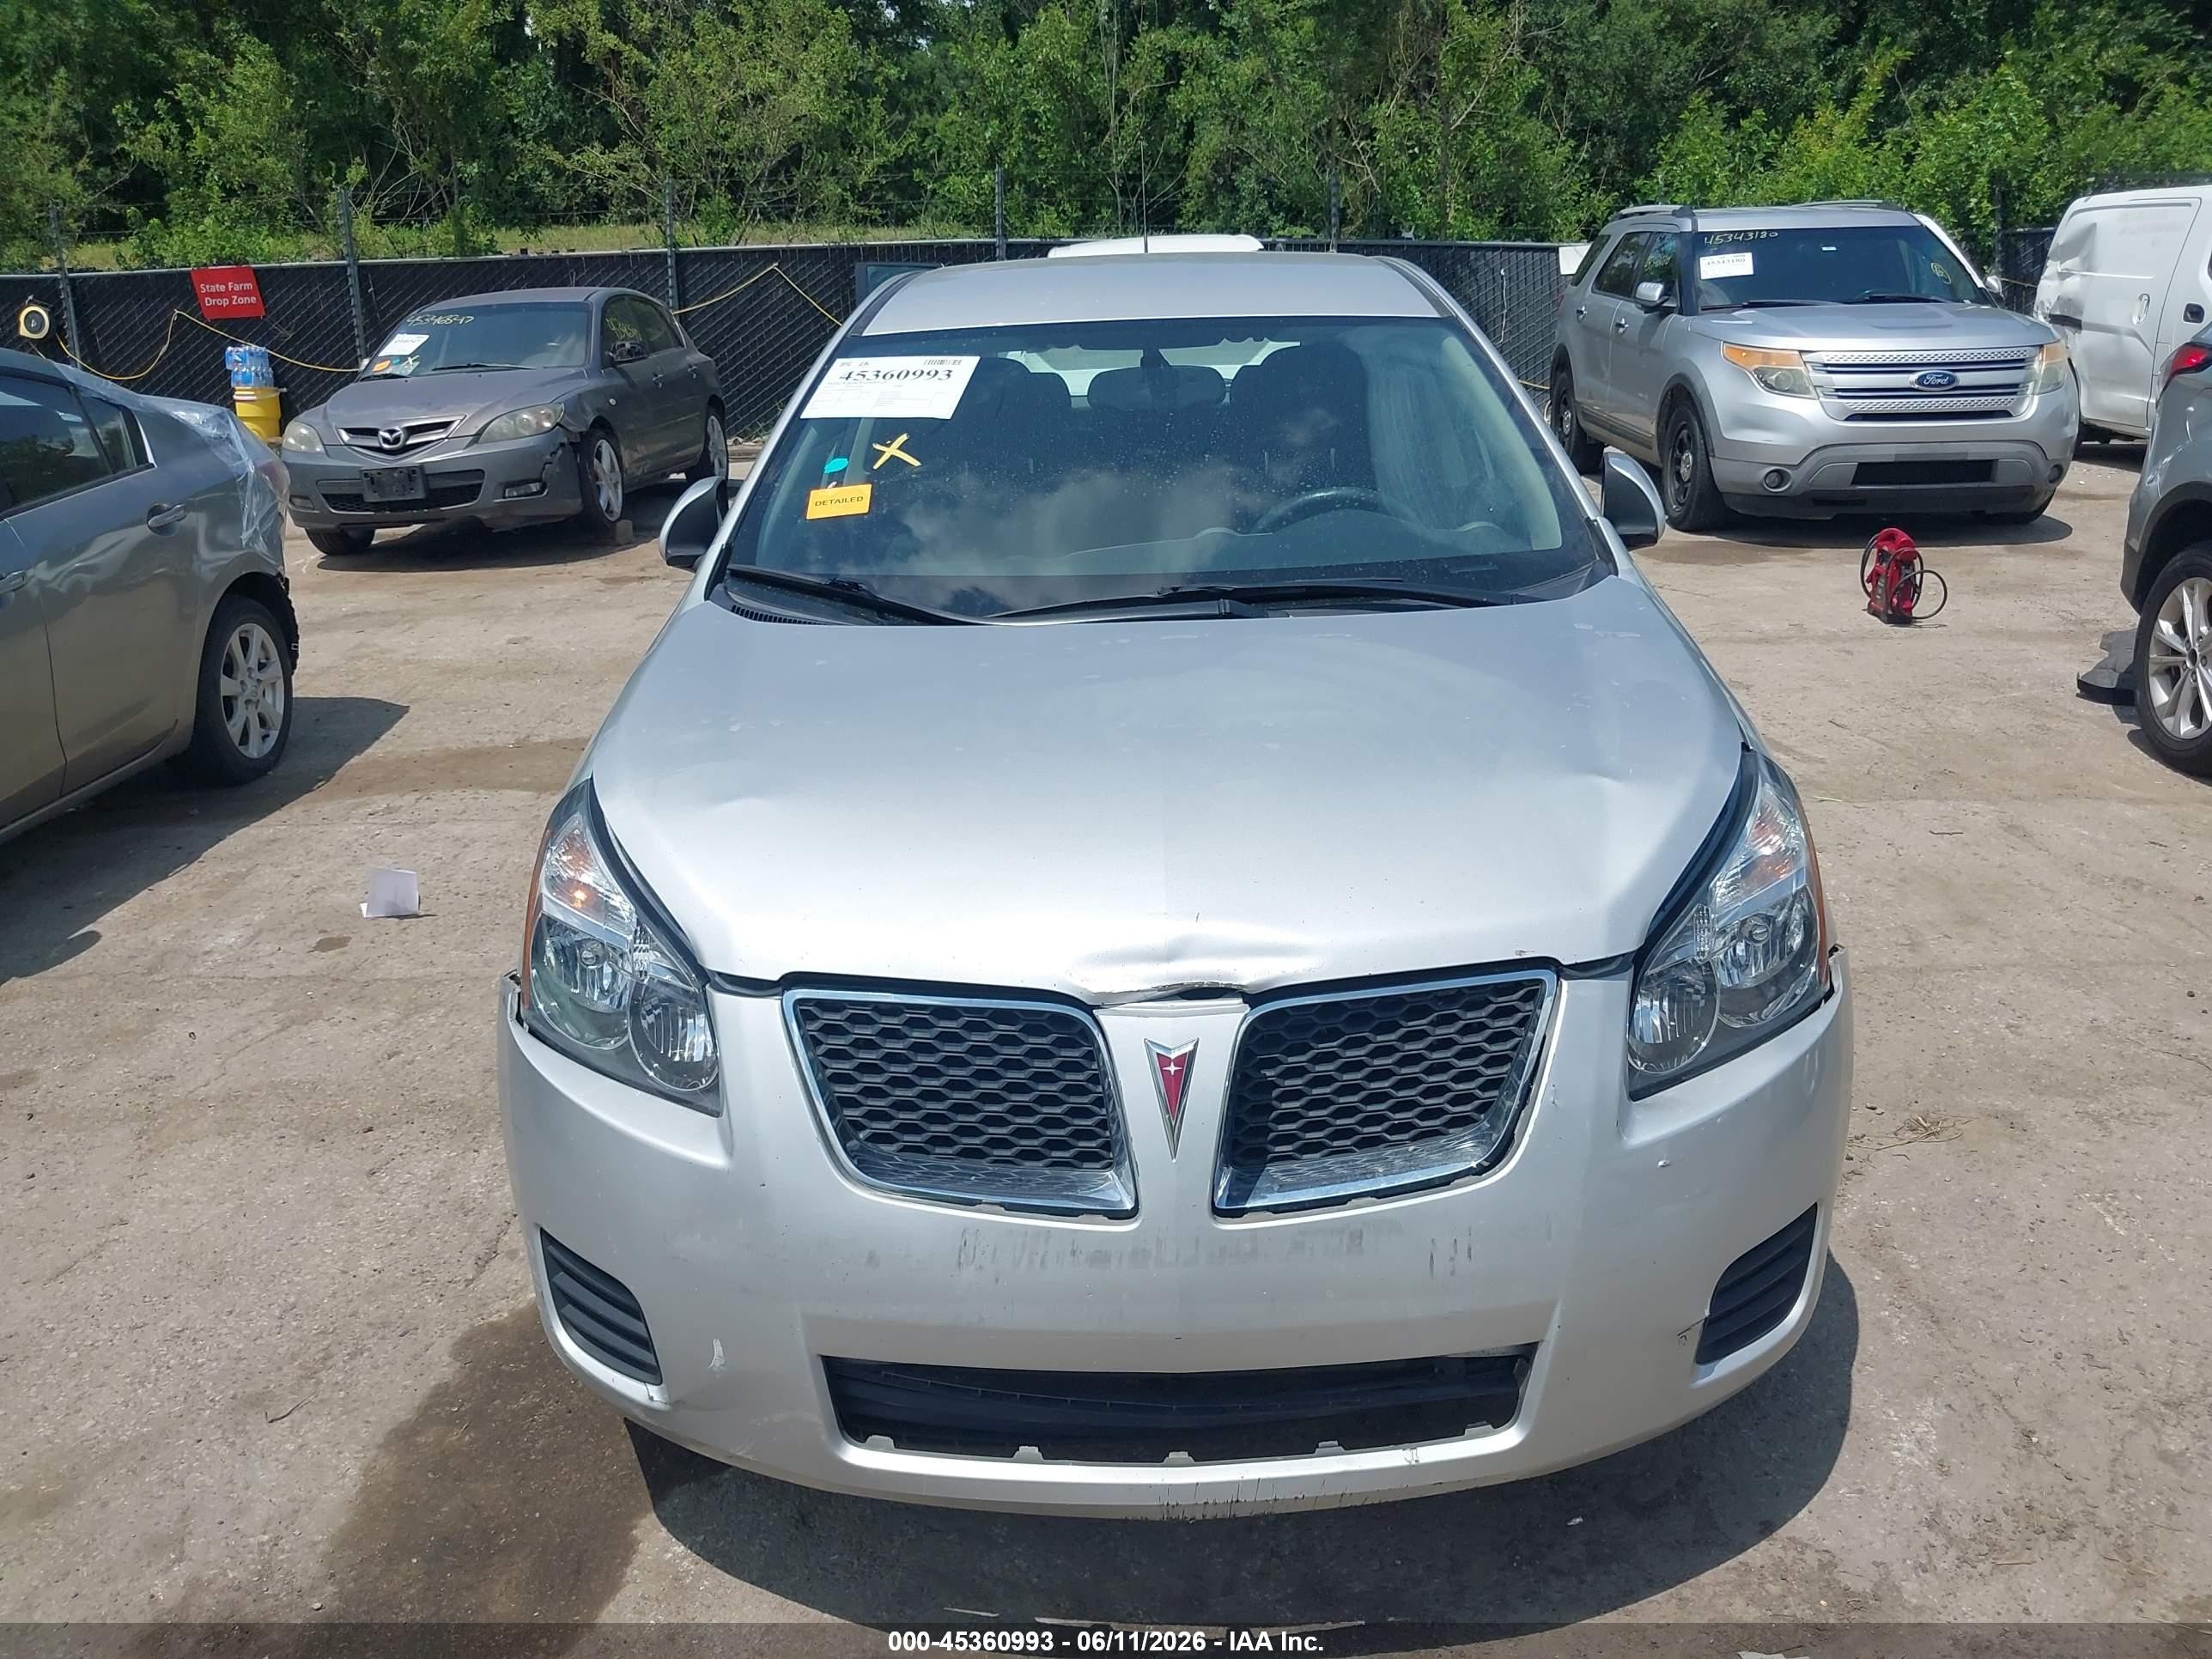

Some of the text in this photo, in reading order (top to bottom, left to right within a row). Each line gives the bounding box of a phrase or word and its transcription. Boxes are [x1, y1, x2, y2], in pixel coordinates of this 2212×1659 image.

[1704, 230, 1779, 246] 45343180
[200, 282, 253, 294] State Farm
[204, 295, 257, 308] Drop Zone
[838, 369, 953, 381] 45360993
[1923, 374, 1949, 386] Ford
[814, 496, 864, 507] DETAILED
